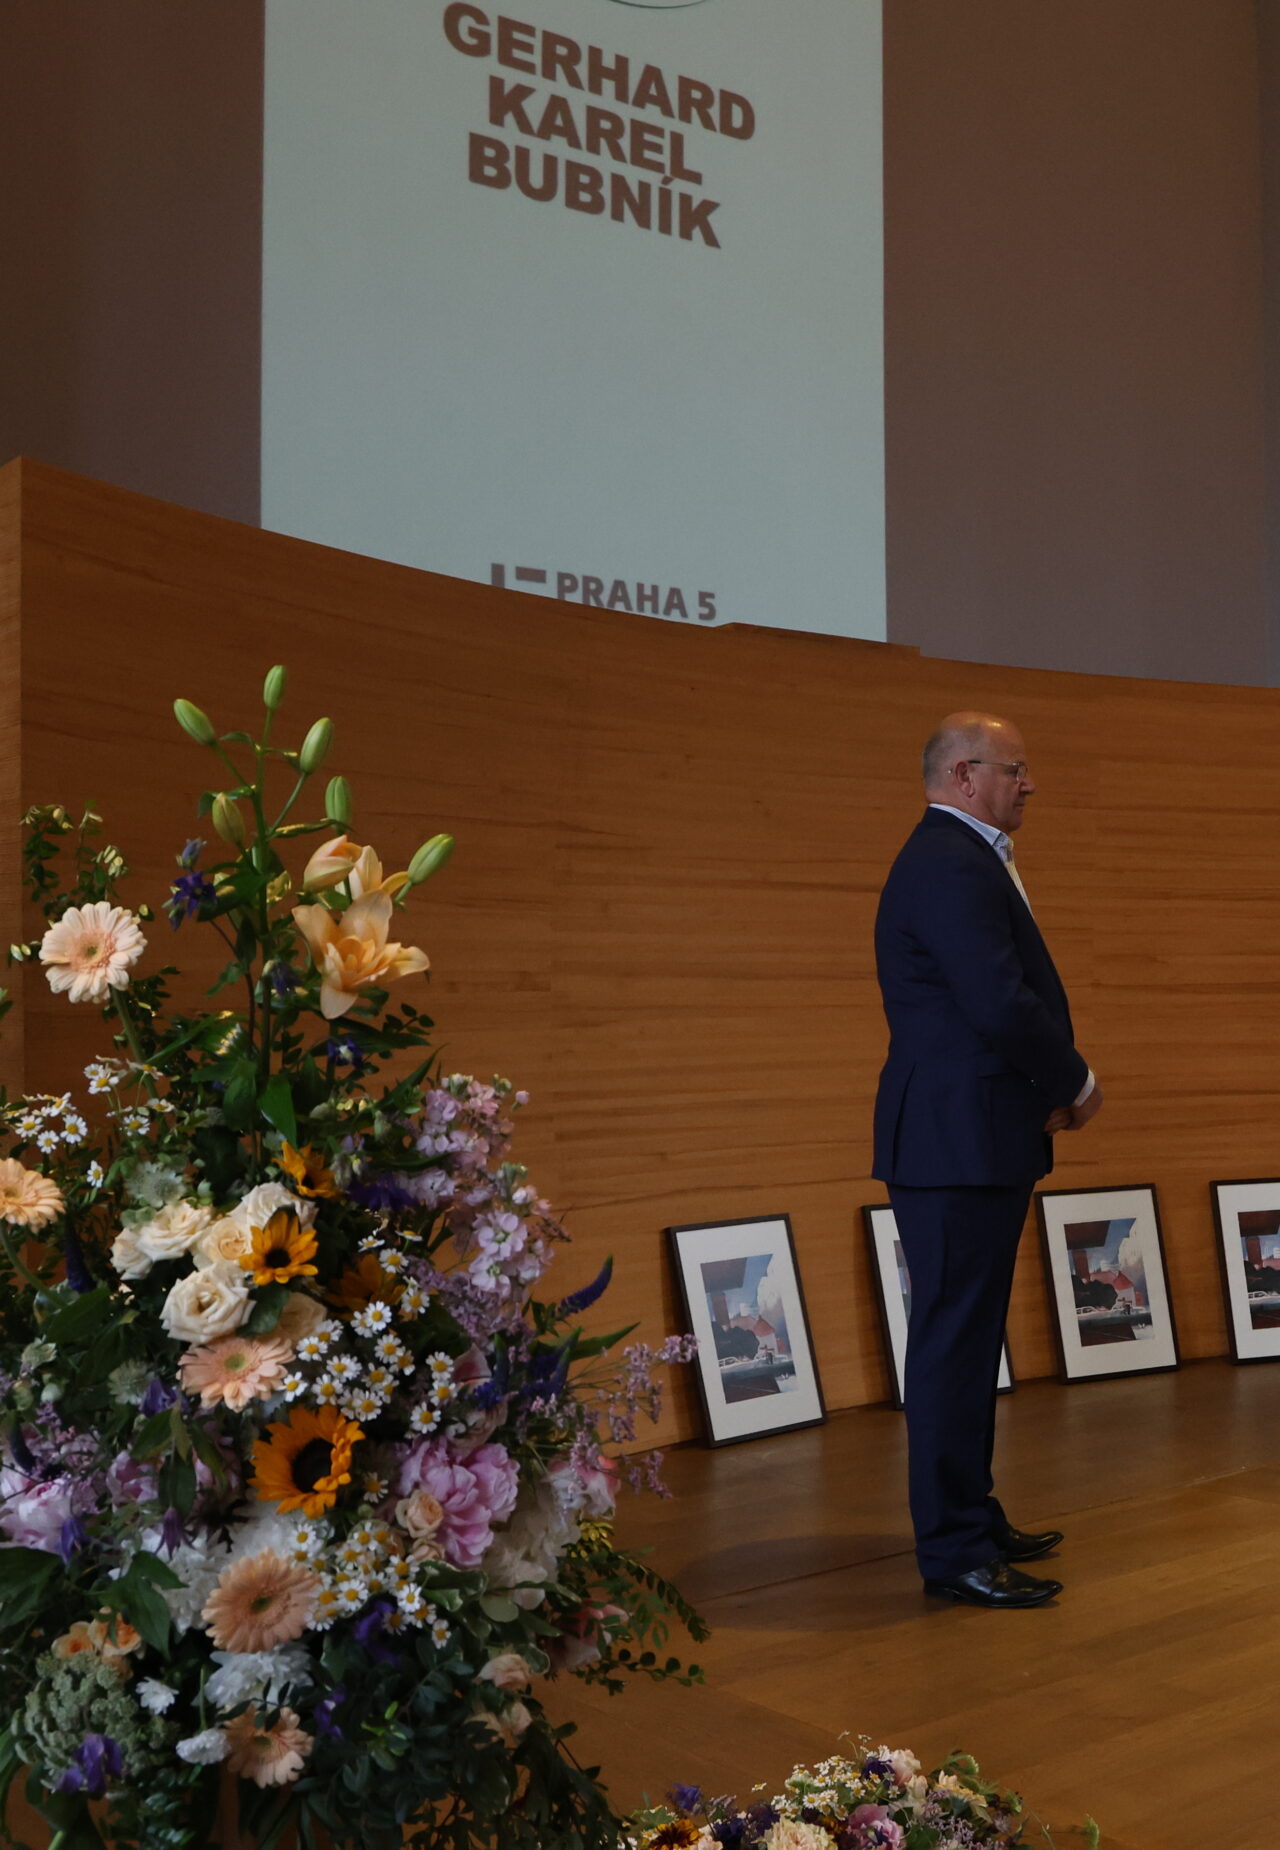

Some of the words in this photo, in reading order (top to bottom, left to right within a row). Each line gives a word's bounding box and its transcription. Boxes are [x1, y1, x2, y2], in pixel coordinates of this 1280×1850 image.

[443, 2, 756, 141] GERHARD
[489, 75, 703, 186] KAREL
[468, 131, 722, 250] BUBNÍK
[556, 571, 689, 618] PRAHA
[697, 590, 717, 621] 5
